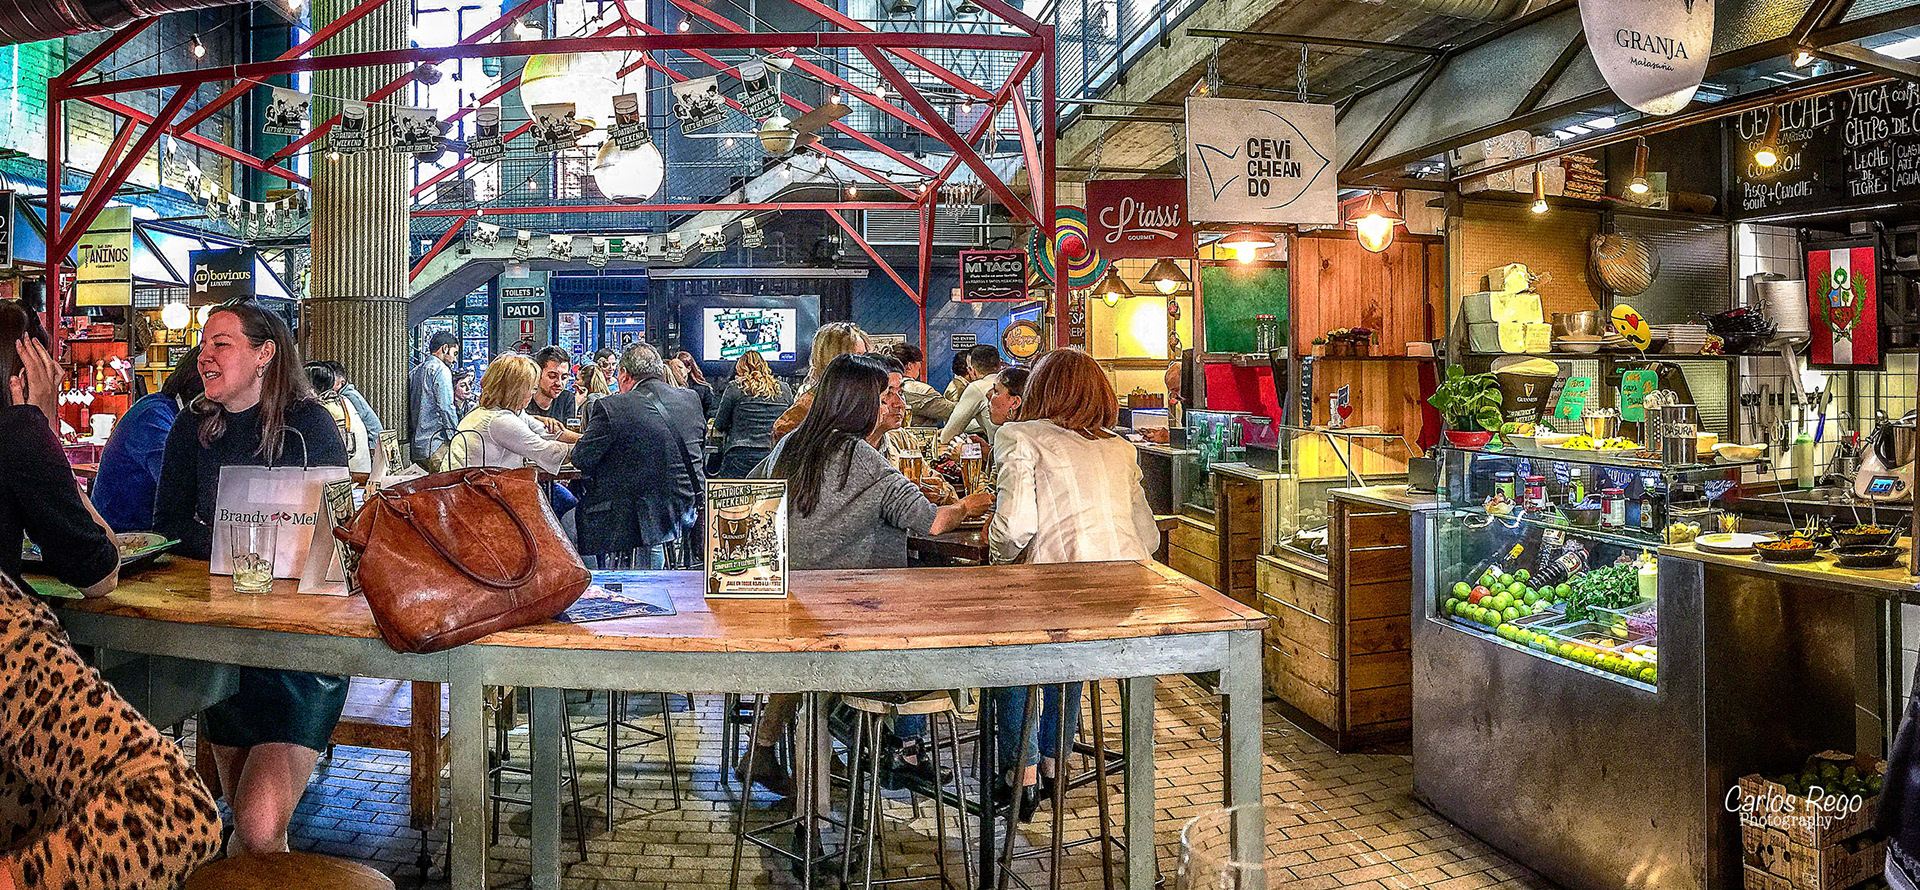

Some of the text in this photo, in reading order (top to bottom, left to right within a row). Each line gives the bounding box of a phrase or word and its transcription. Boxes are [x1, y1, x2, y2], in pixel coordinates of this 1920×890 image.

[1616, 28, 1689, 60] GRANJA
[1847, 84, 1892, 119] YUCA
[1846, 116, 1889, 146] CHIPS
[1892, 115, 1910, 135] DE
[1853, 147, 1888, 170] LECHE
[1247, 160, 1301, 178] CHEAN
[1861, 169, 1875, 181] DE
[1248, 178, 1270, 197] DO
[1849, 177, 1887, 197] TIGRE
[1743, 196, 1767, 211] SOUR
[1127, 233, 1156, 241] GOURMET
[80, 245, 128, 268] TANINOS
[965, 261, 1022, 273] MI TACO
[210, 269, 251, 281] bovinus
[505, 289, 531, 297] TOILETS
[507, 305, 540, 316] PATIO
[1664, 425, 1693, 435] BASURA
[718, 485, 751, 498] PATRICK'S
[715, 496, 750, 509] WEEKEND
[219, 509, 269, 526] Brandy
